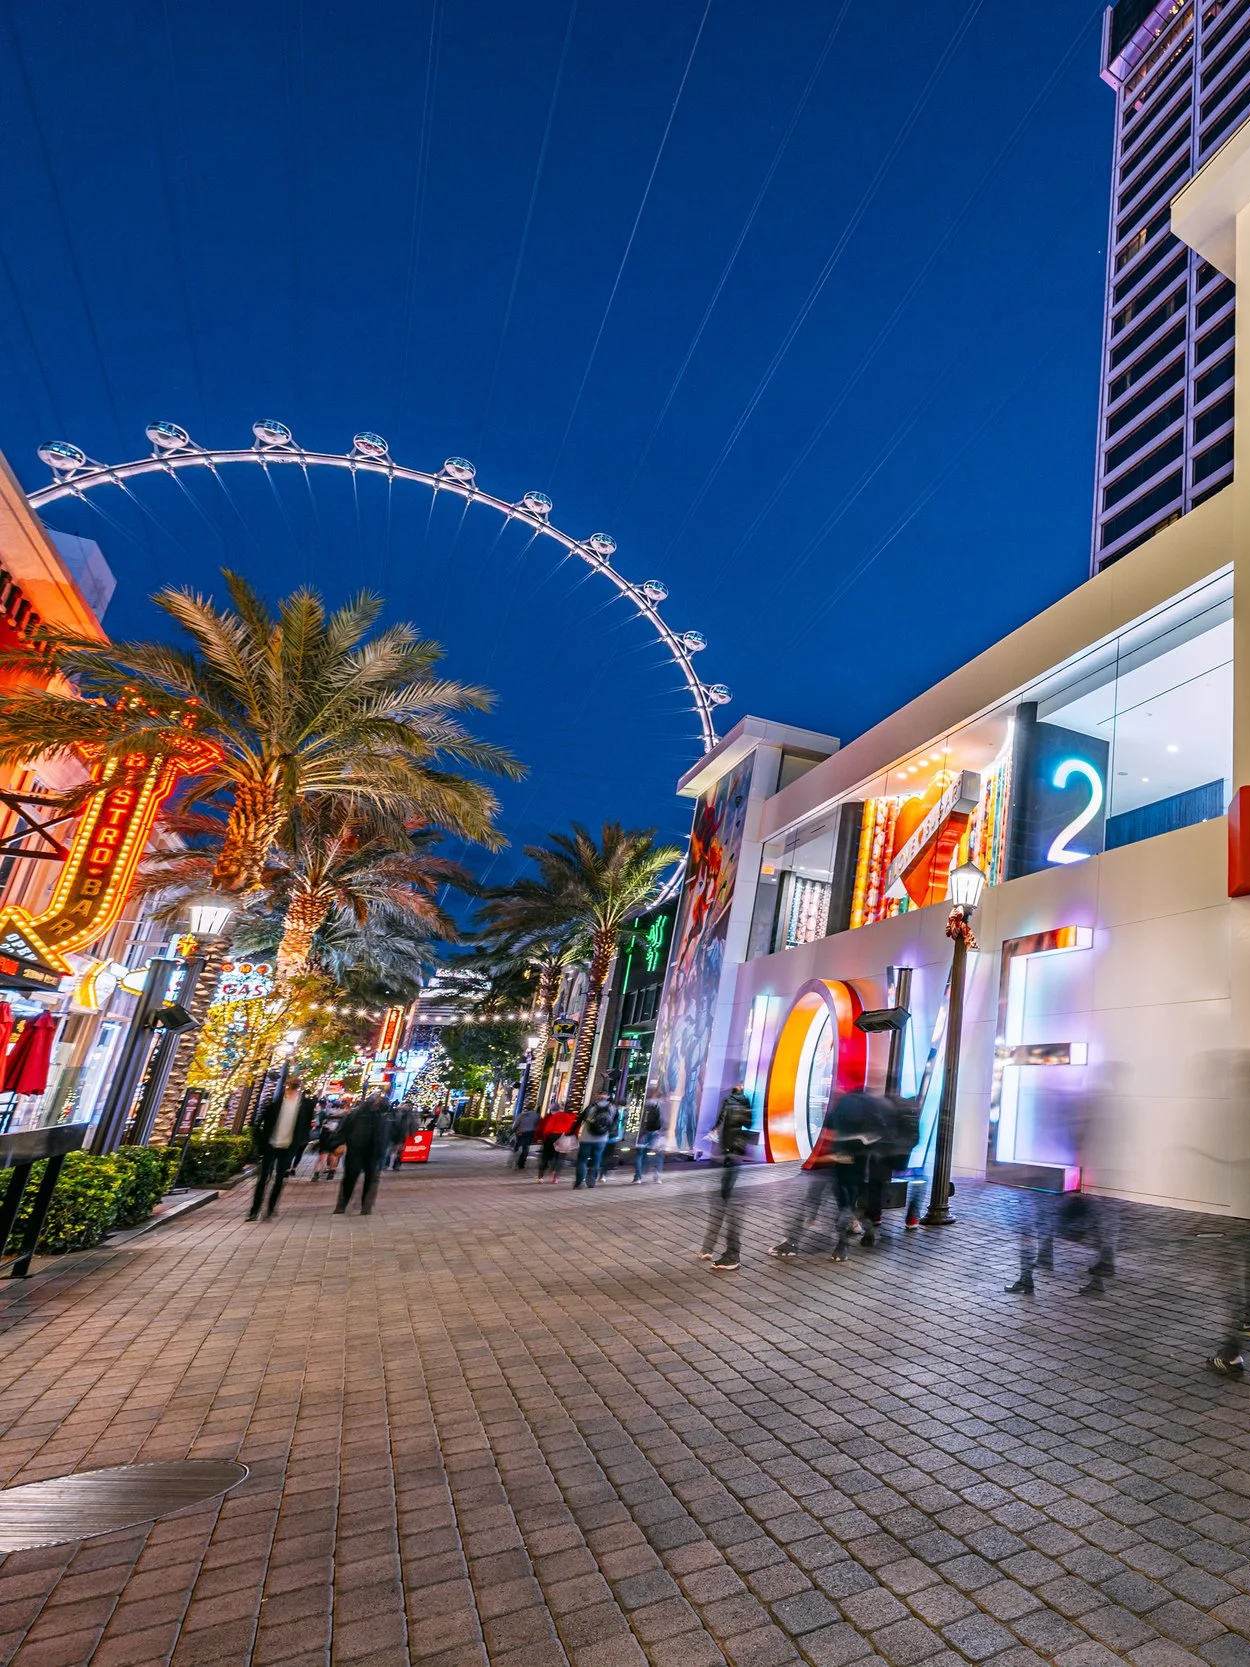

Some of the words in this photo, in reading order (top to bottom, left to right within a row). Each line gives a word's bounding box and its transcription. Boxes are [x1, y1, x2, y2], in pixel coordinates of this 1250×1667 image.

[1046, 757, 1105, 864] 2
[48, 879, 102, 936] BAR
[222, 983, 265, 998] GAS
